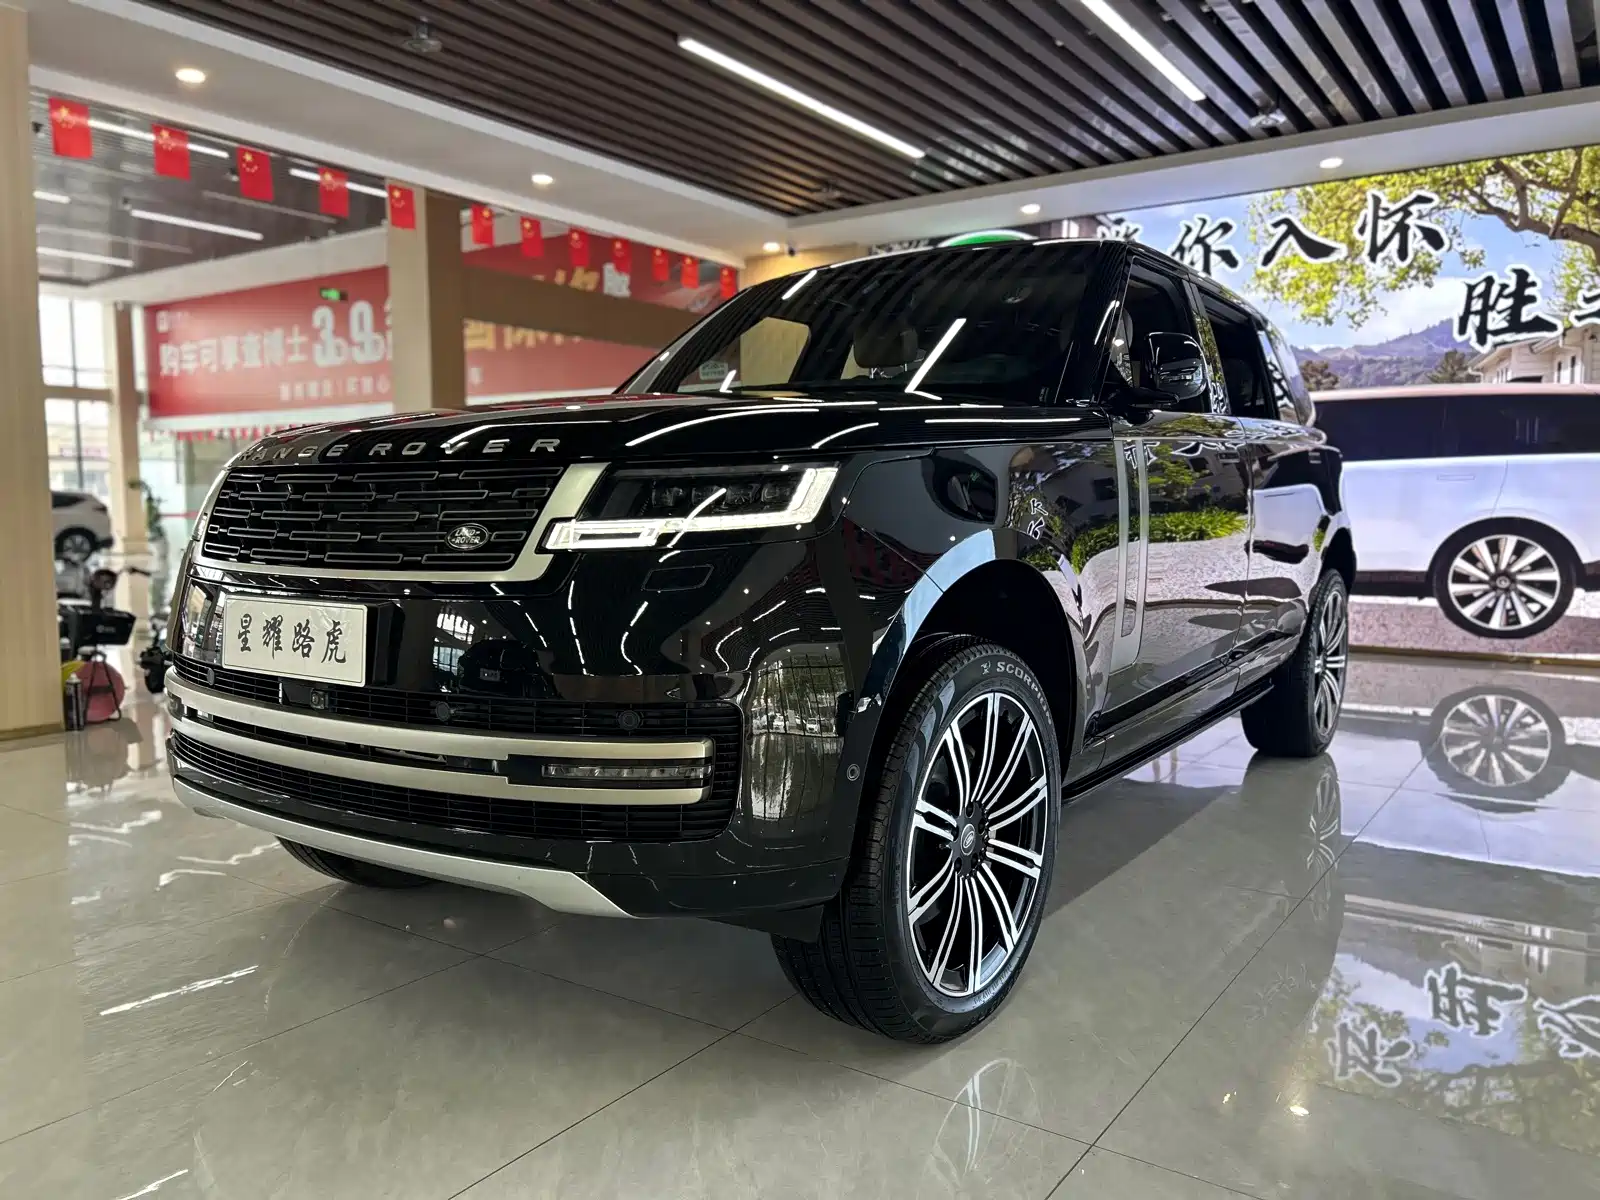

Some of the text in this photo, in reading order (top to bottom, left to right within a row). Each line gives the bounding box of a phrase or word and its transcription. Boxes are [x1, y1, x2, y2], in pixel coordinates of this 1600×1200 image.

[1457, 268, 1600, 347] 胜
[368, 437, 561, 457] ROVER
[237, 613, 347, 664] 星耀路虎
